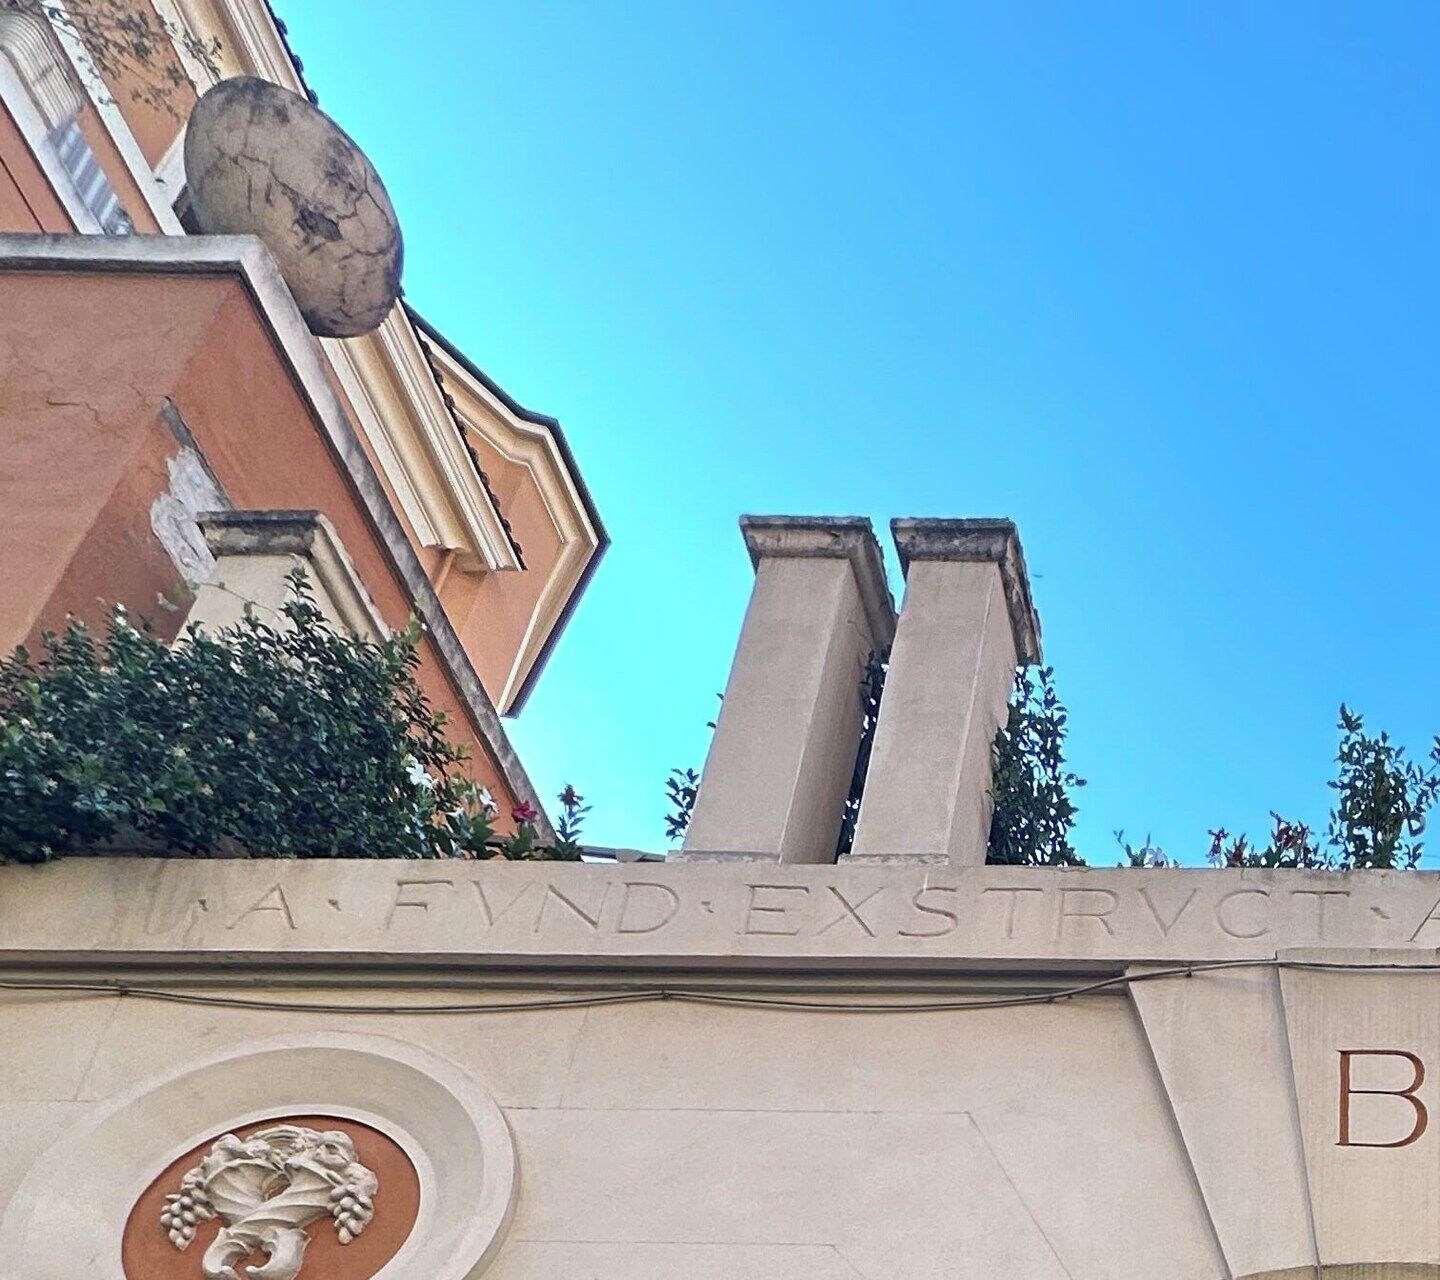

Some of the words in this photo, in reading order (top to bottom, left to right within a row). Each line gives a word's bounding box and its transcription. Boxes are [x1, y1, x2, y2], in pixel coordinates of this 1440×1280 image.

[376, 879, 681, 936] FVND
[735, 882, 1351, 943] EXSTRVCT
[1335, 1049, 1429, 1148] B
